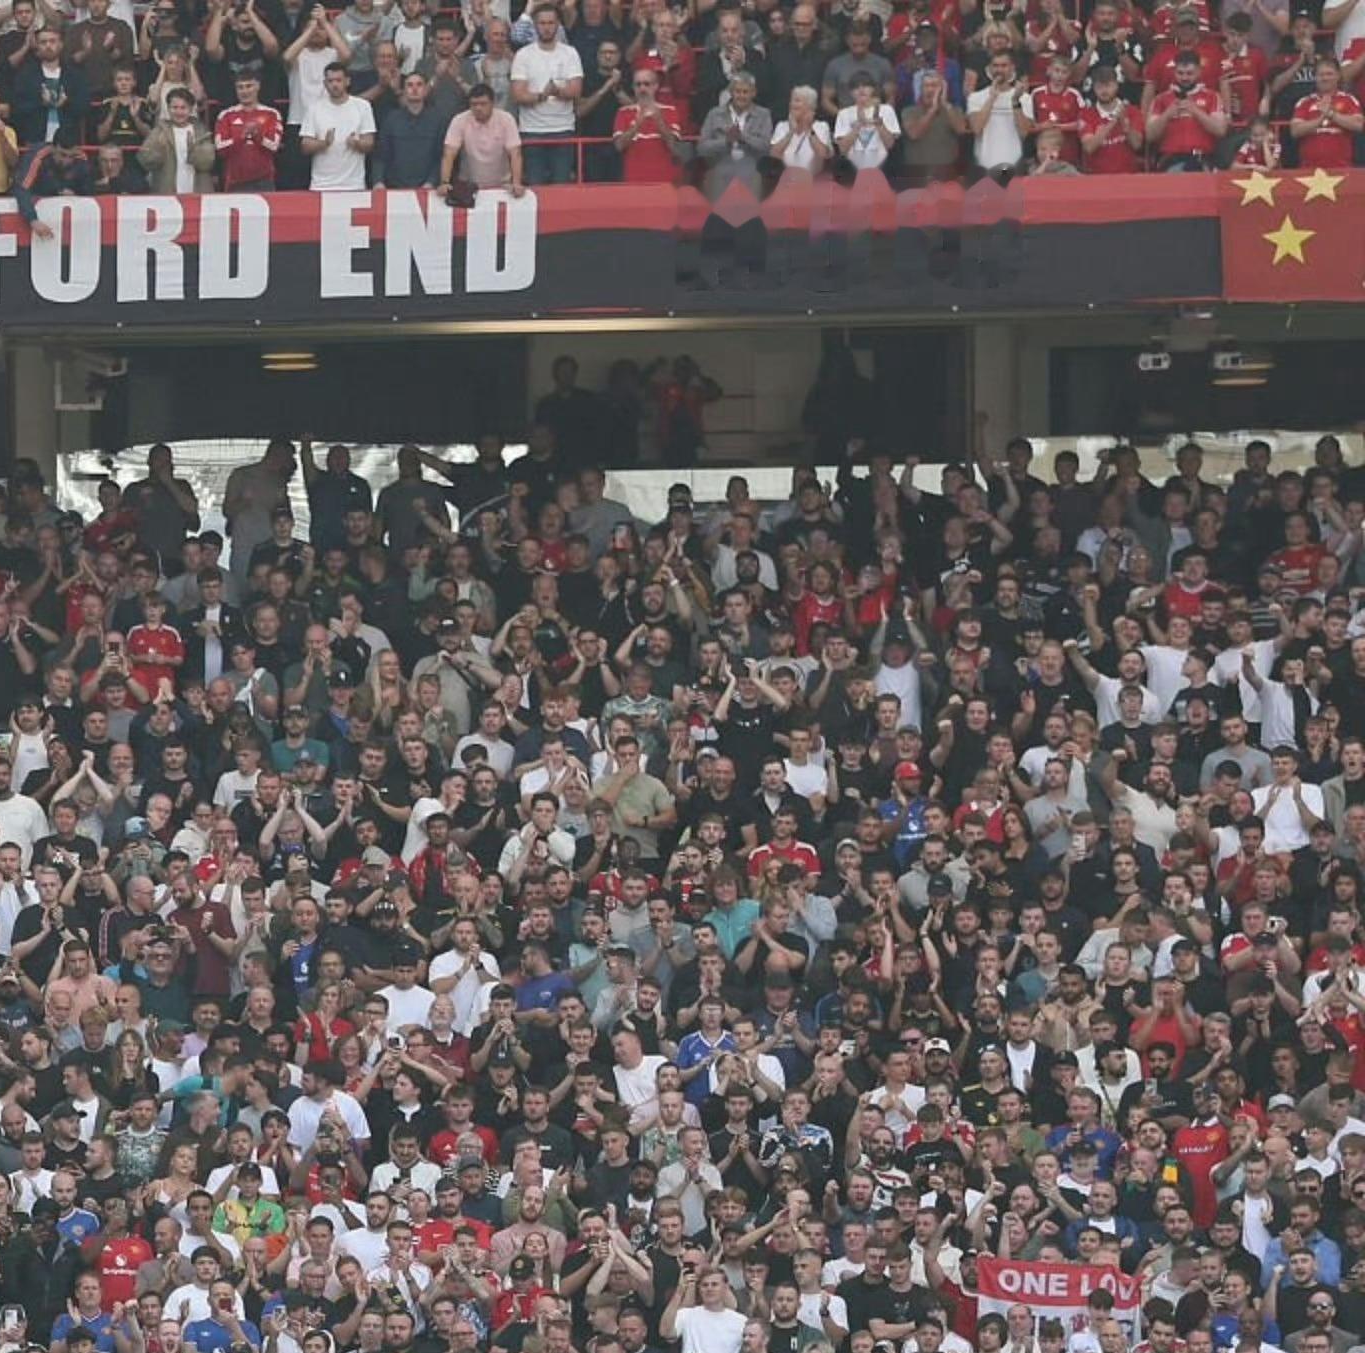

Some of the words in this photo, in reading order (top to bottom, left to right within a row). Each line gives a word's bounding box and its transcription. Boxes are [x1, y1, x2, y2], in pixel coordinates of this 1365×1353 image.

[320, 188, 537, 298] END
[998, 1269, 1067, 1296] ONE
[1080, 1273, 1137, 1300] LOV
